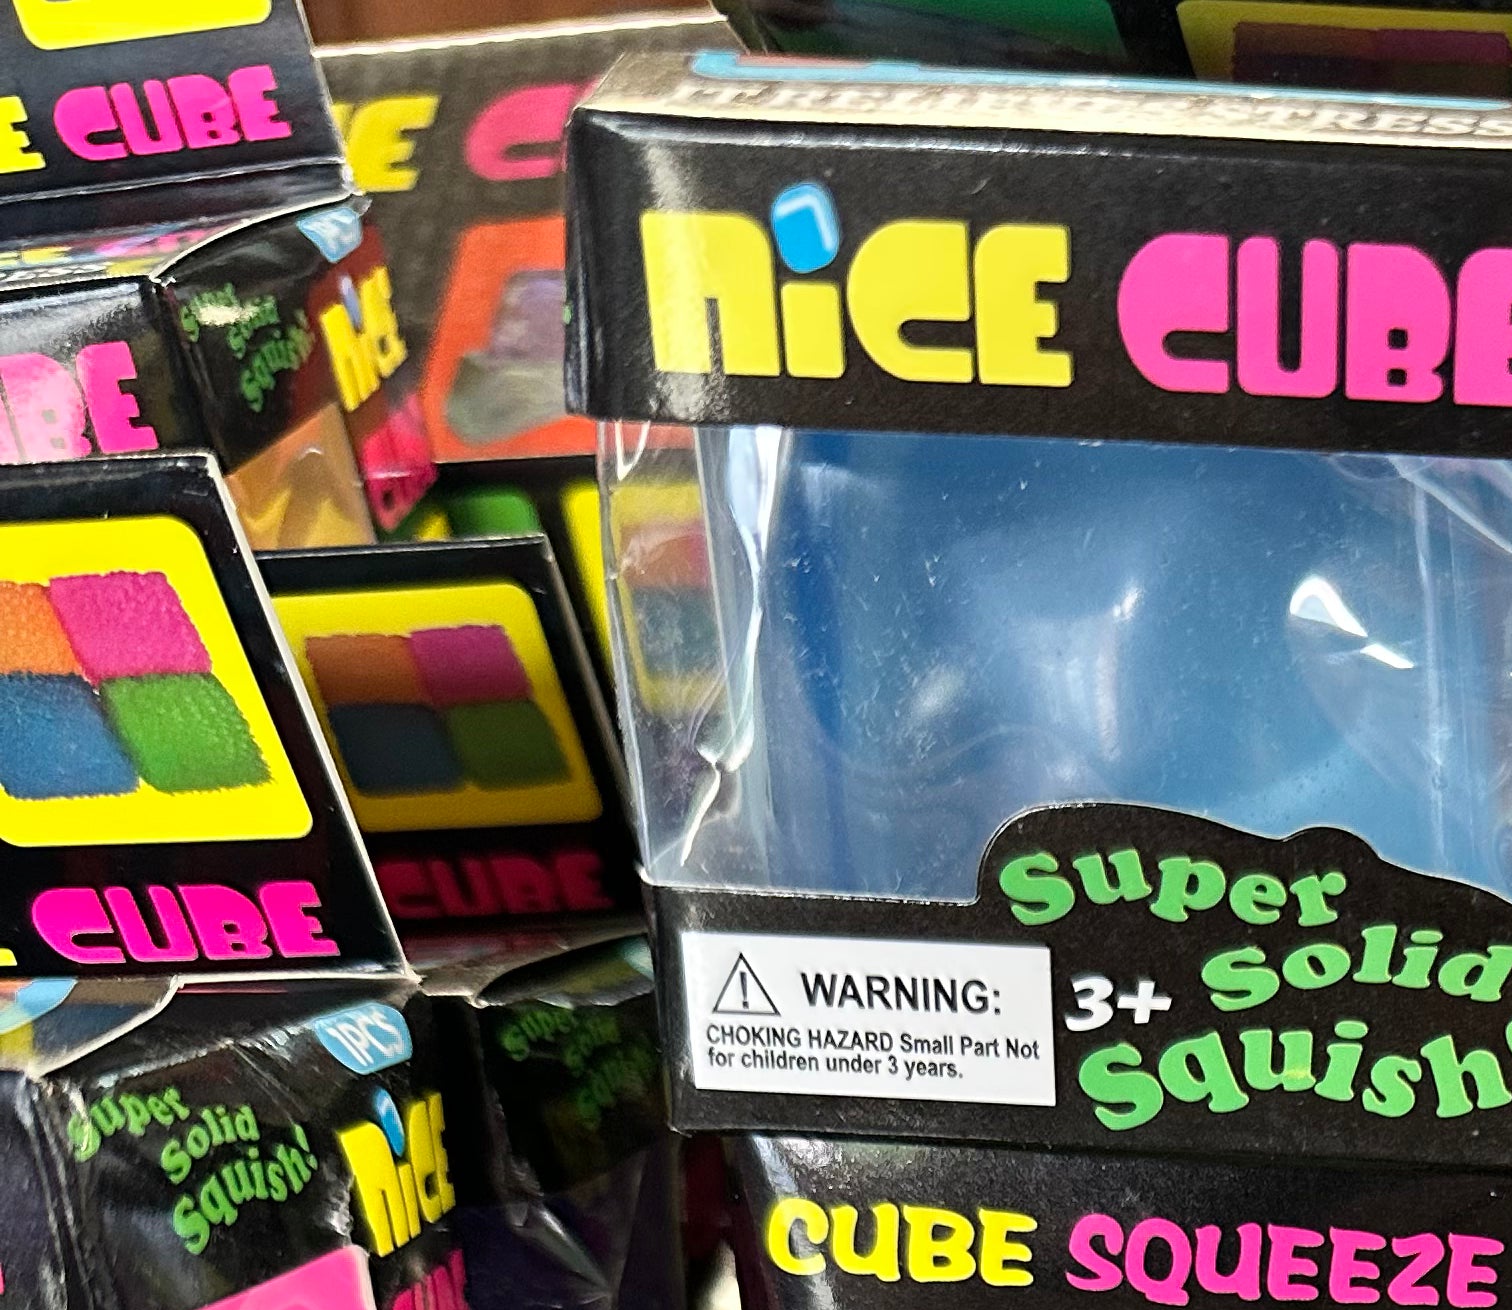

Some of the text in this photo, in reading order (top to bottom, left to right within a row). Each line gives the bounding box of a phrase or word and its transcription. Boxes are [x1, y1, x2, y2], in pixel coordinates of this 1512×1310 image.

[53, 64, 292, 161] CUBE
[332, 94, 441, 193] E
[0, 341, 159, 465] BE
[31, 881, 340, 964] CUBE
[998, 846, 1348, 928] Super
[800, 971, 1001, 1016] WARNING:
[1063, 974, 1173, 1034] 3+
[705, 1023, 1040, 1060] CHOKING HAZARD Small Part Not
[707, 1047, 964, 1081] for children under 3 years.
[67, 1085, 191, 1163] Super
[172, 1122, 319, 1255] Squish!
[764, 1196, 1506, 1309] CUBE SQUEEZE
